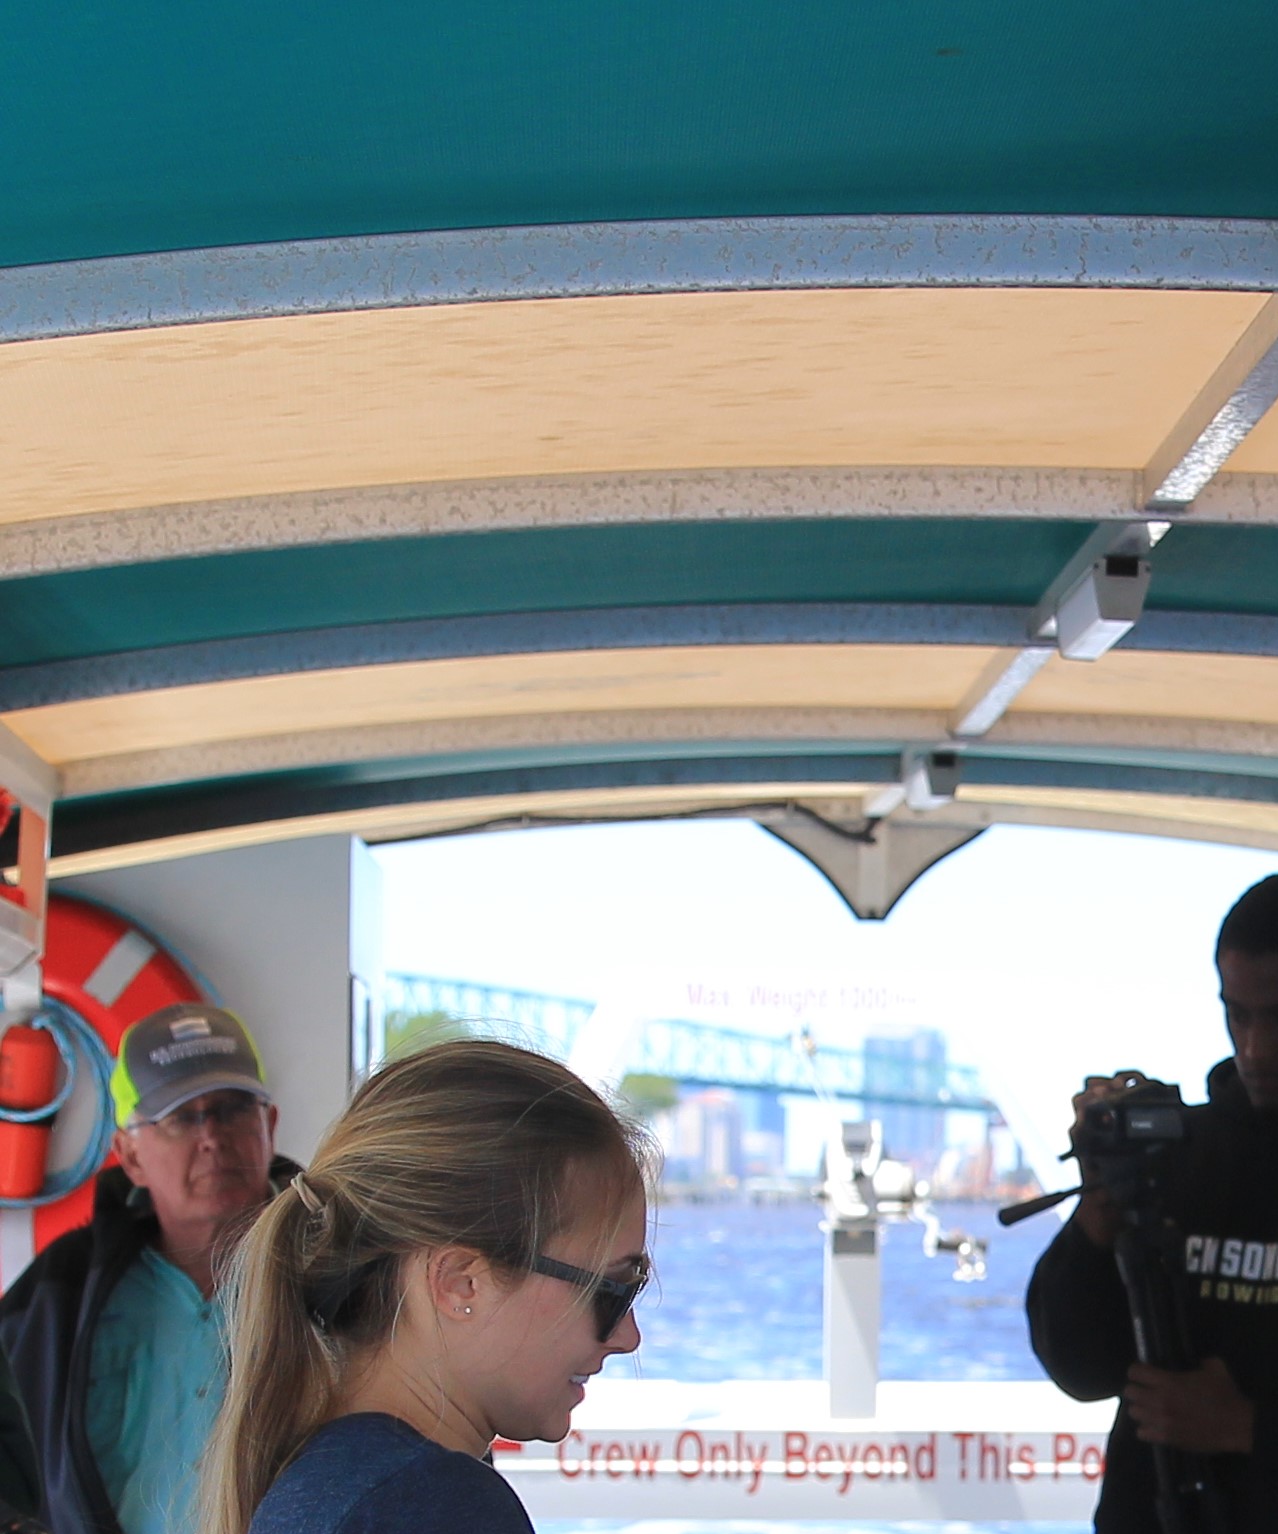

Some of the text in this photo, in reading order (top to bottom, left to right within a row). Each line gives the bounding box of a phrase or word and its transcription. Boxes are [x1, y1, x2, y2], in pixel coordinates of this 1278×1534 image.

[557, 1430, 1106, 1495] Crew Only Beyond This Po
